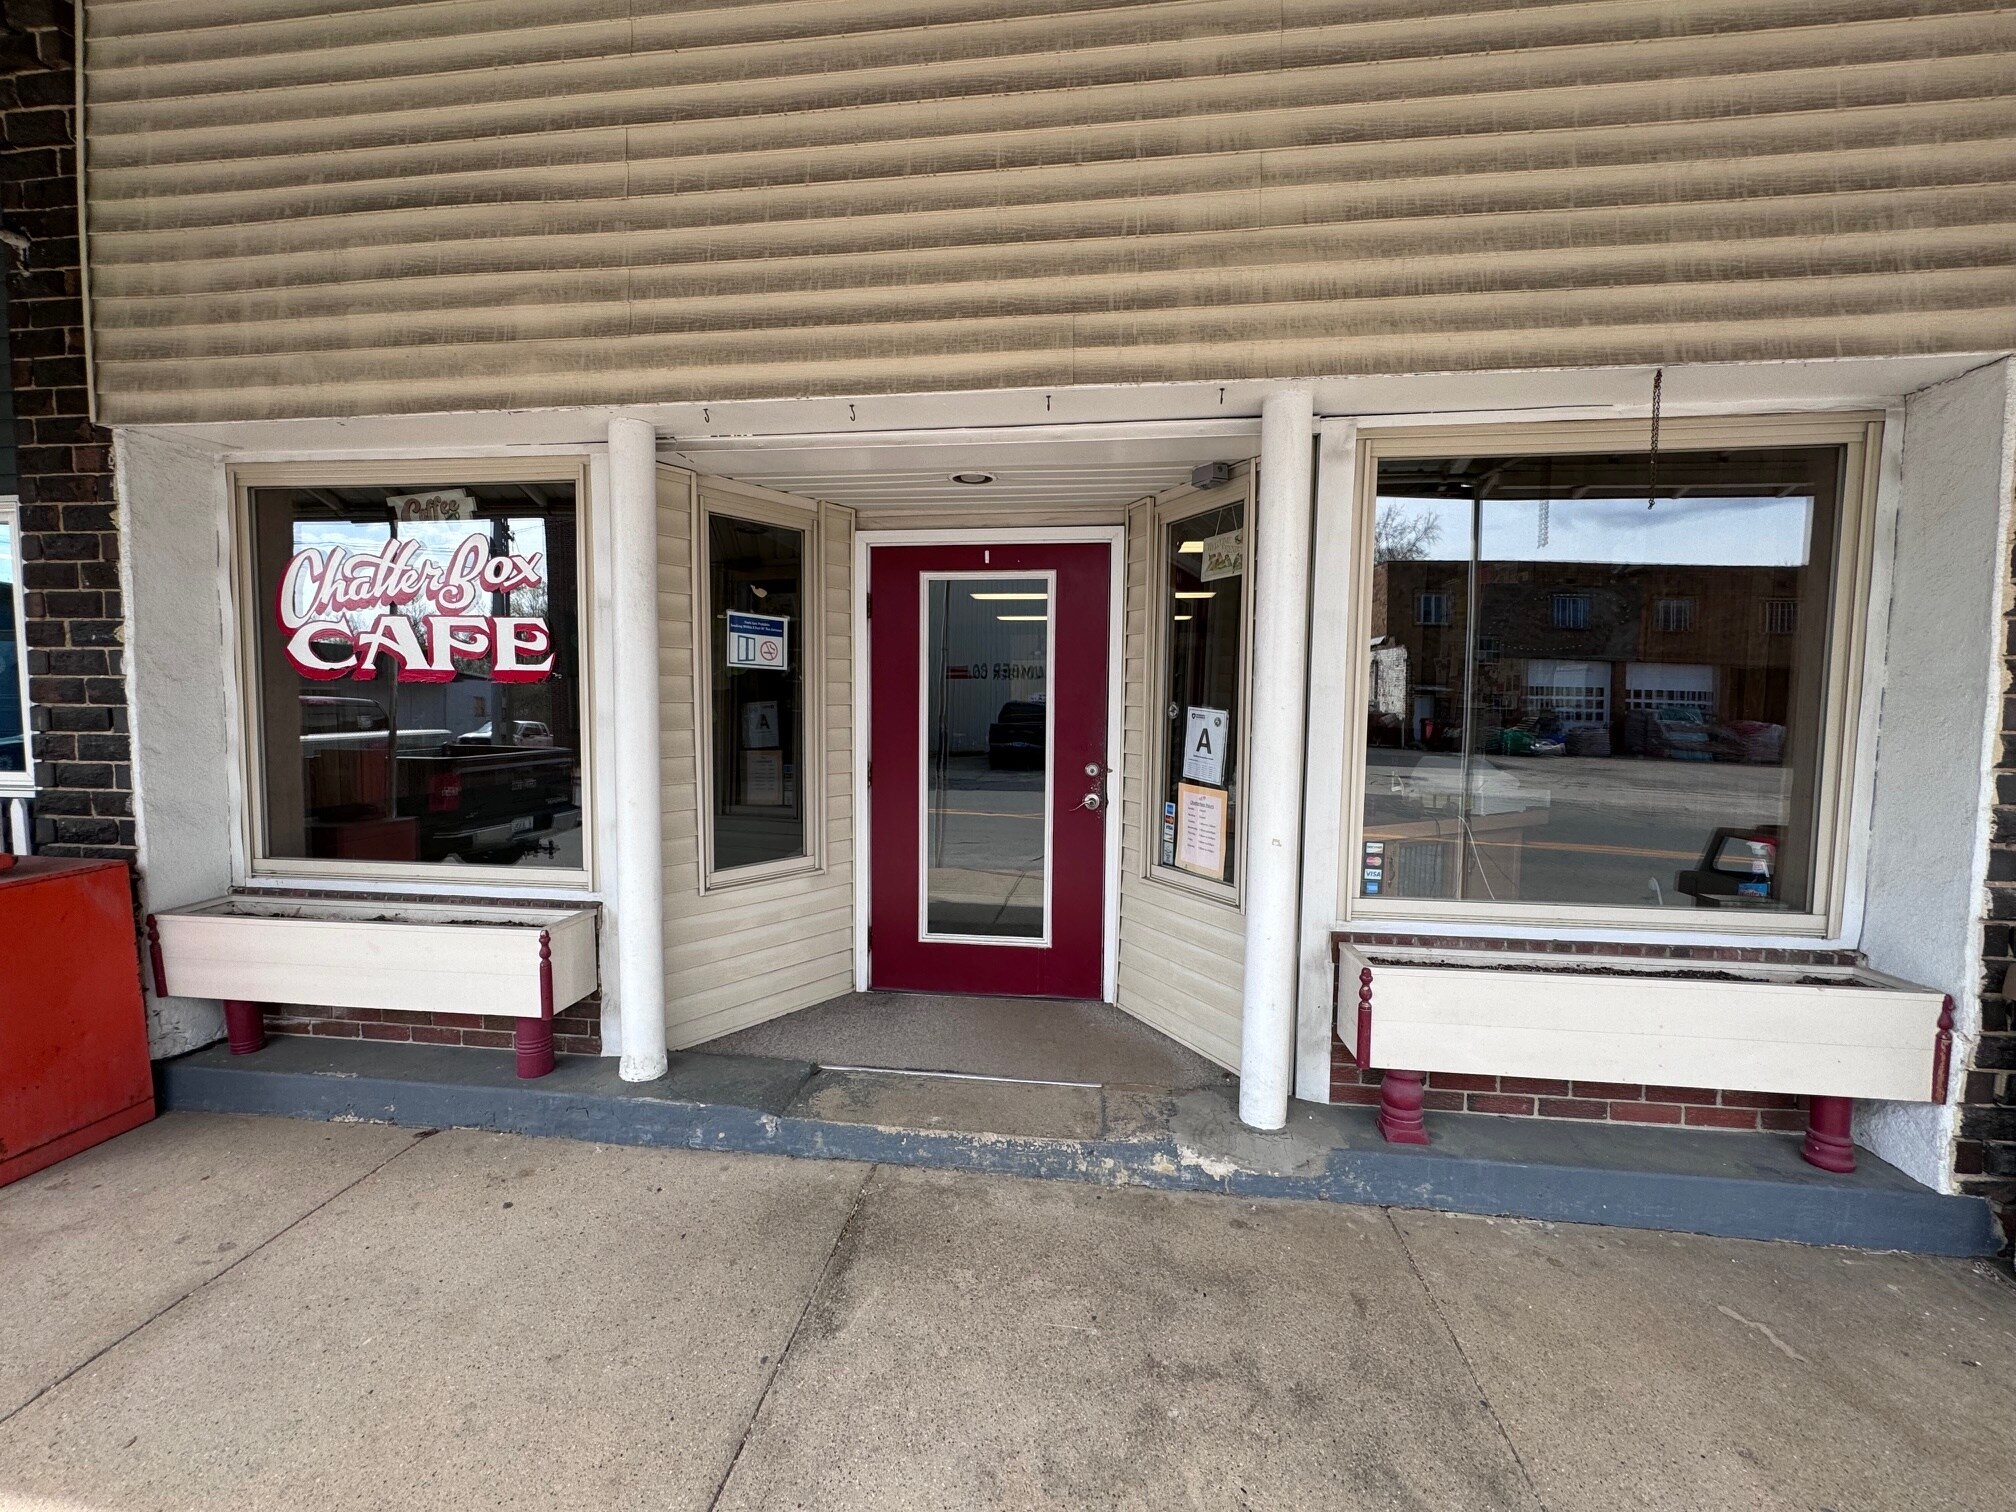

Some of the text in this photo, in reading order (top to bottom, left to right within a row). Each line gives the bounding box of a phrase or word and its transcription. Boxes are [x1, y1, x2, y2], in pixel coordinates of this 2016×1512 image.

[401, 496, 460, 520] Coffee
[284, 613, 555, 683] CAFE
[1196, 727, 1212, 755] A
